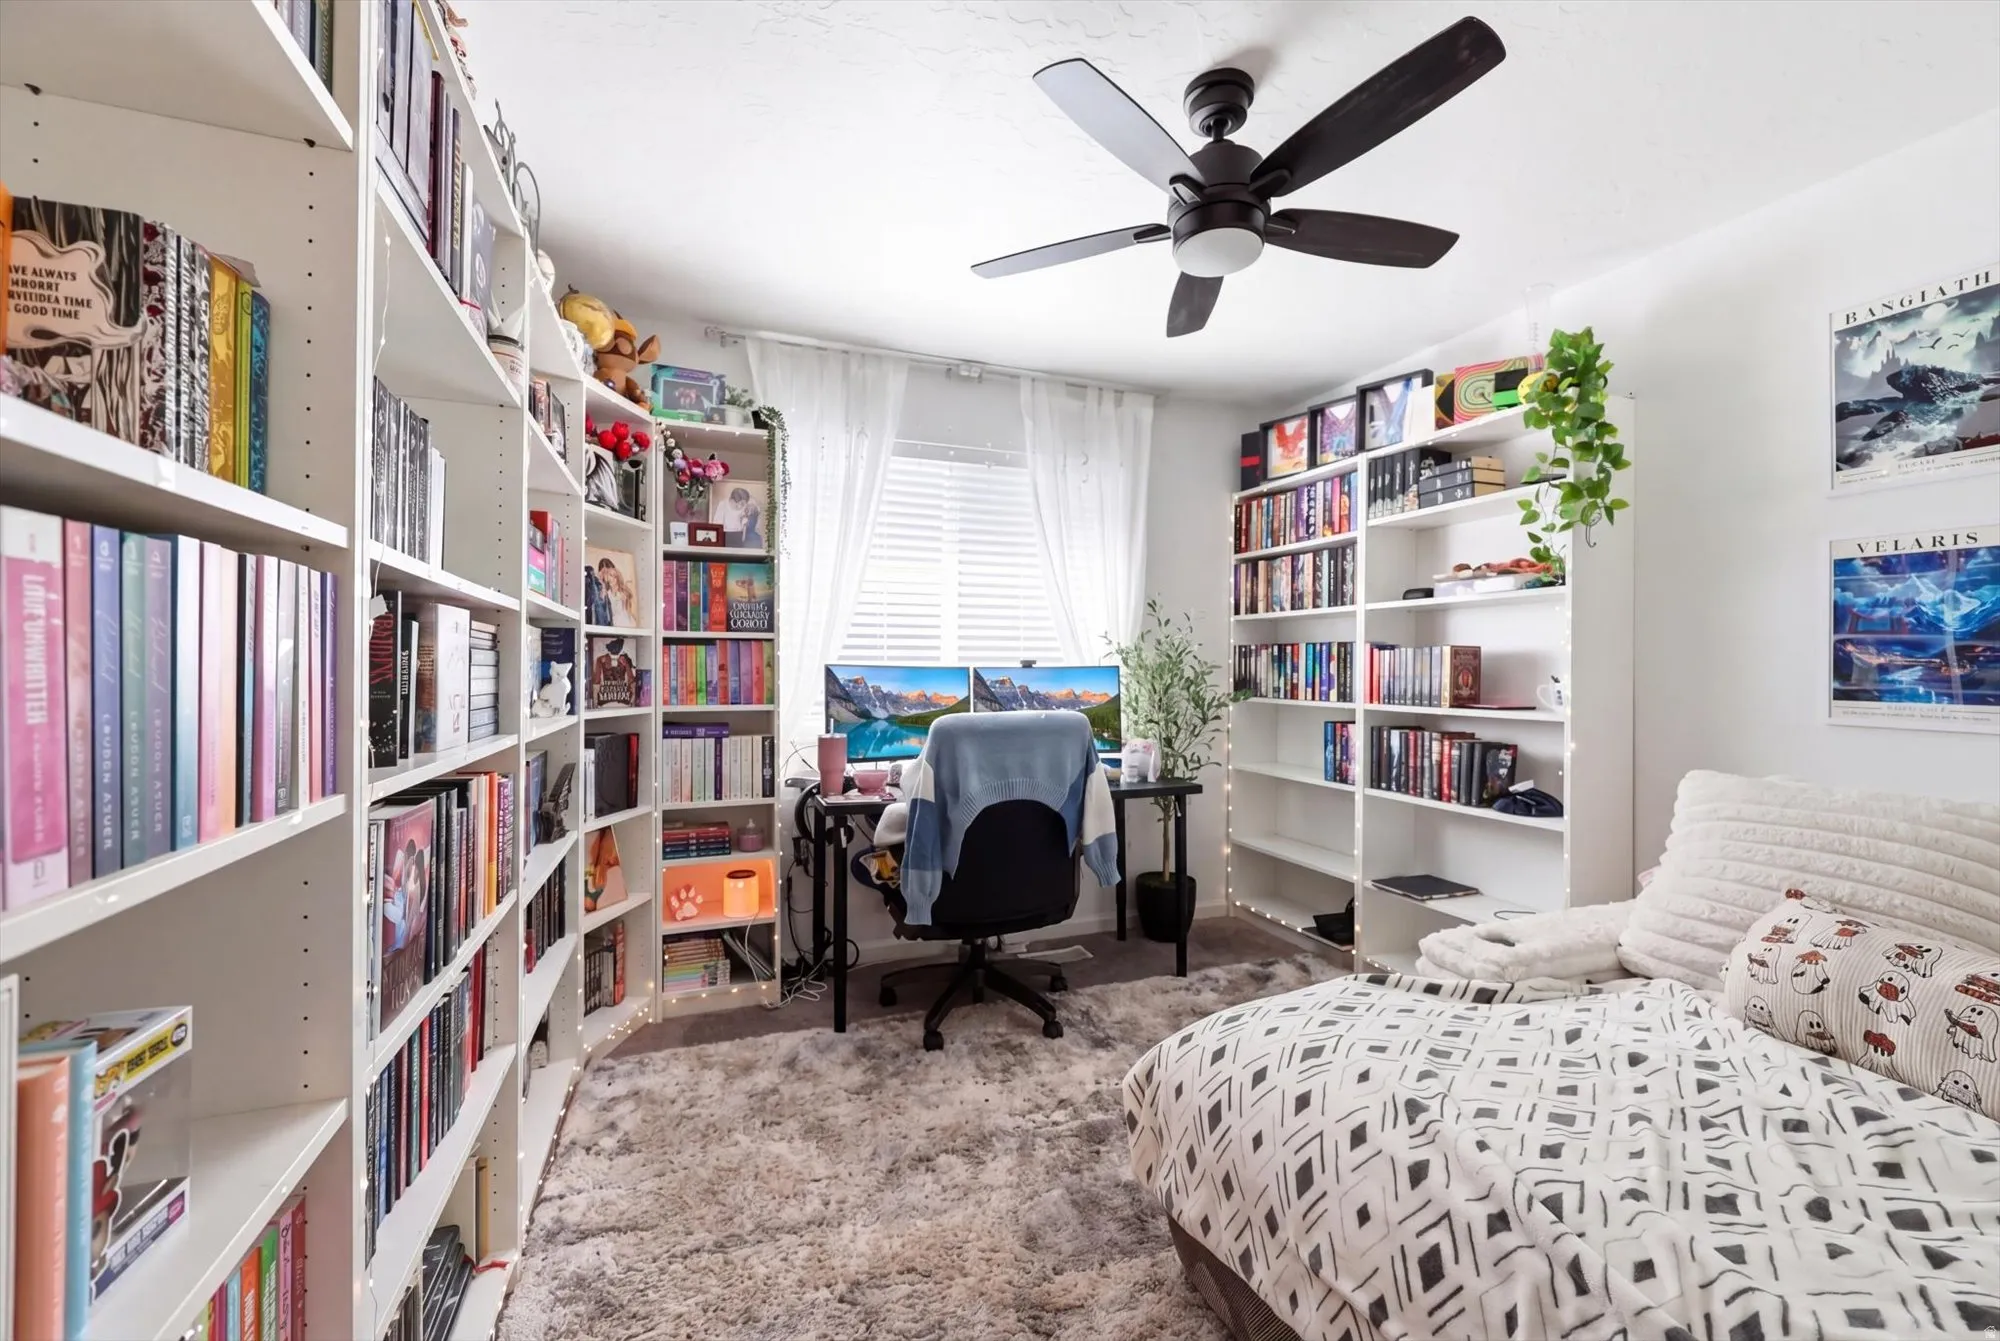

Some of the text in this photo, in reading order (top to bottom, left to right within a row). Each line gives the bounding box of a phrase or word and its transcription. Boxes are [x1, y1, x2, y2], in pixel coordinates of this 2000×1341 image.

[31, 267, 77, 281] ALWAYS
[63, 296, 93, 308] TIME
[1845, 270, 1991, 325] BANGIATH
[14, 303, 81, 320] GOOD TIME
[1856, 531, 1979, 554] VELARIS
